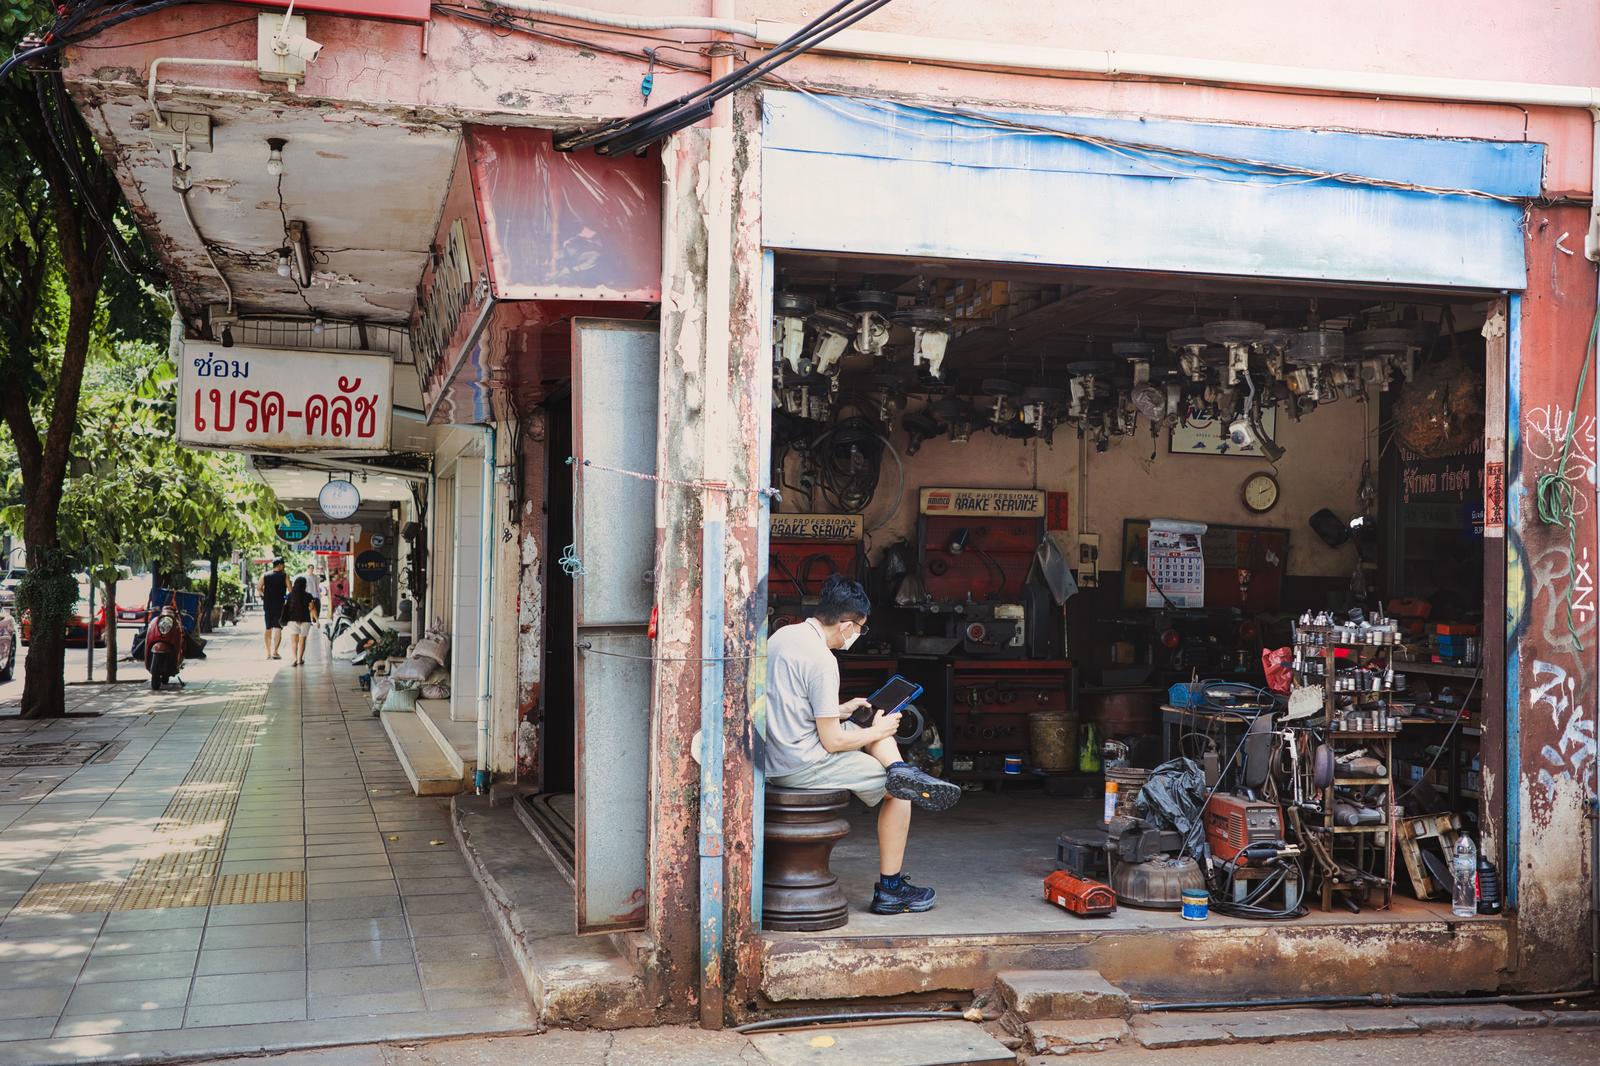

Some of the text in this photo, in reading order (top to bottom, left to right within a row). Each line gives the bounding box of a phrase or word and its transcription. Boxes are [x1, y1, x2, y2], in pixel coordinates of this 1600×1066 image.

[194, 352, 249, 378] ซ่อม
[194, 376, 379, 438] เบรค-คลัช
[954, 498, 990, 511] BRAKE
[994, 499, 1038, 512] SERVICE
[793, 518, 857, 526] PROFESSIONAL
[811, 525, 856, 538] SERVICE
